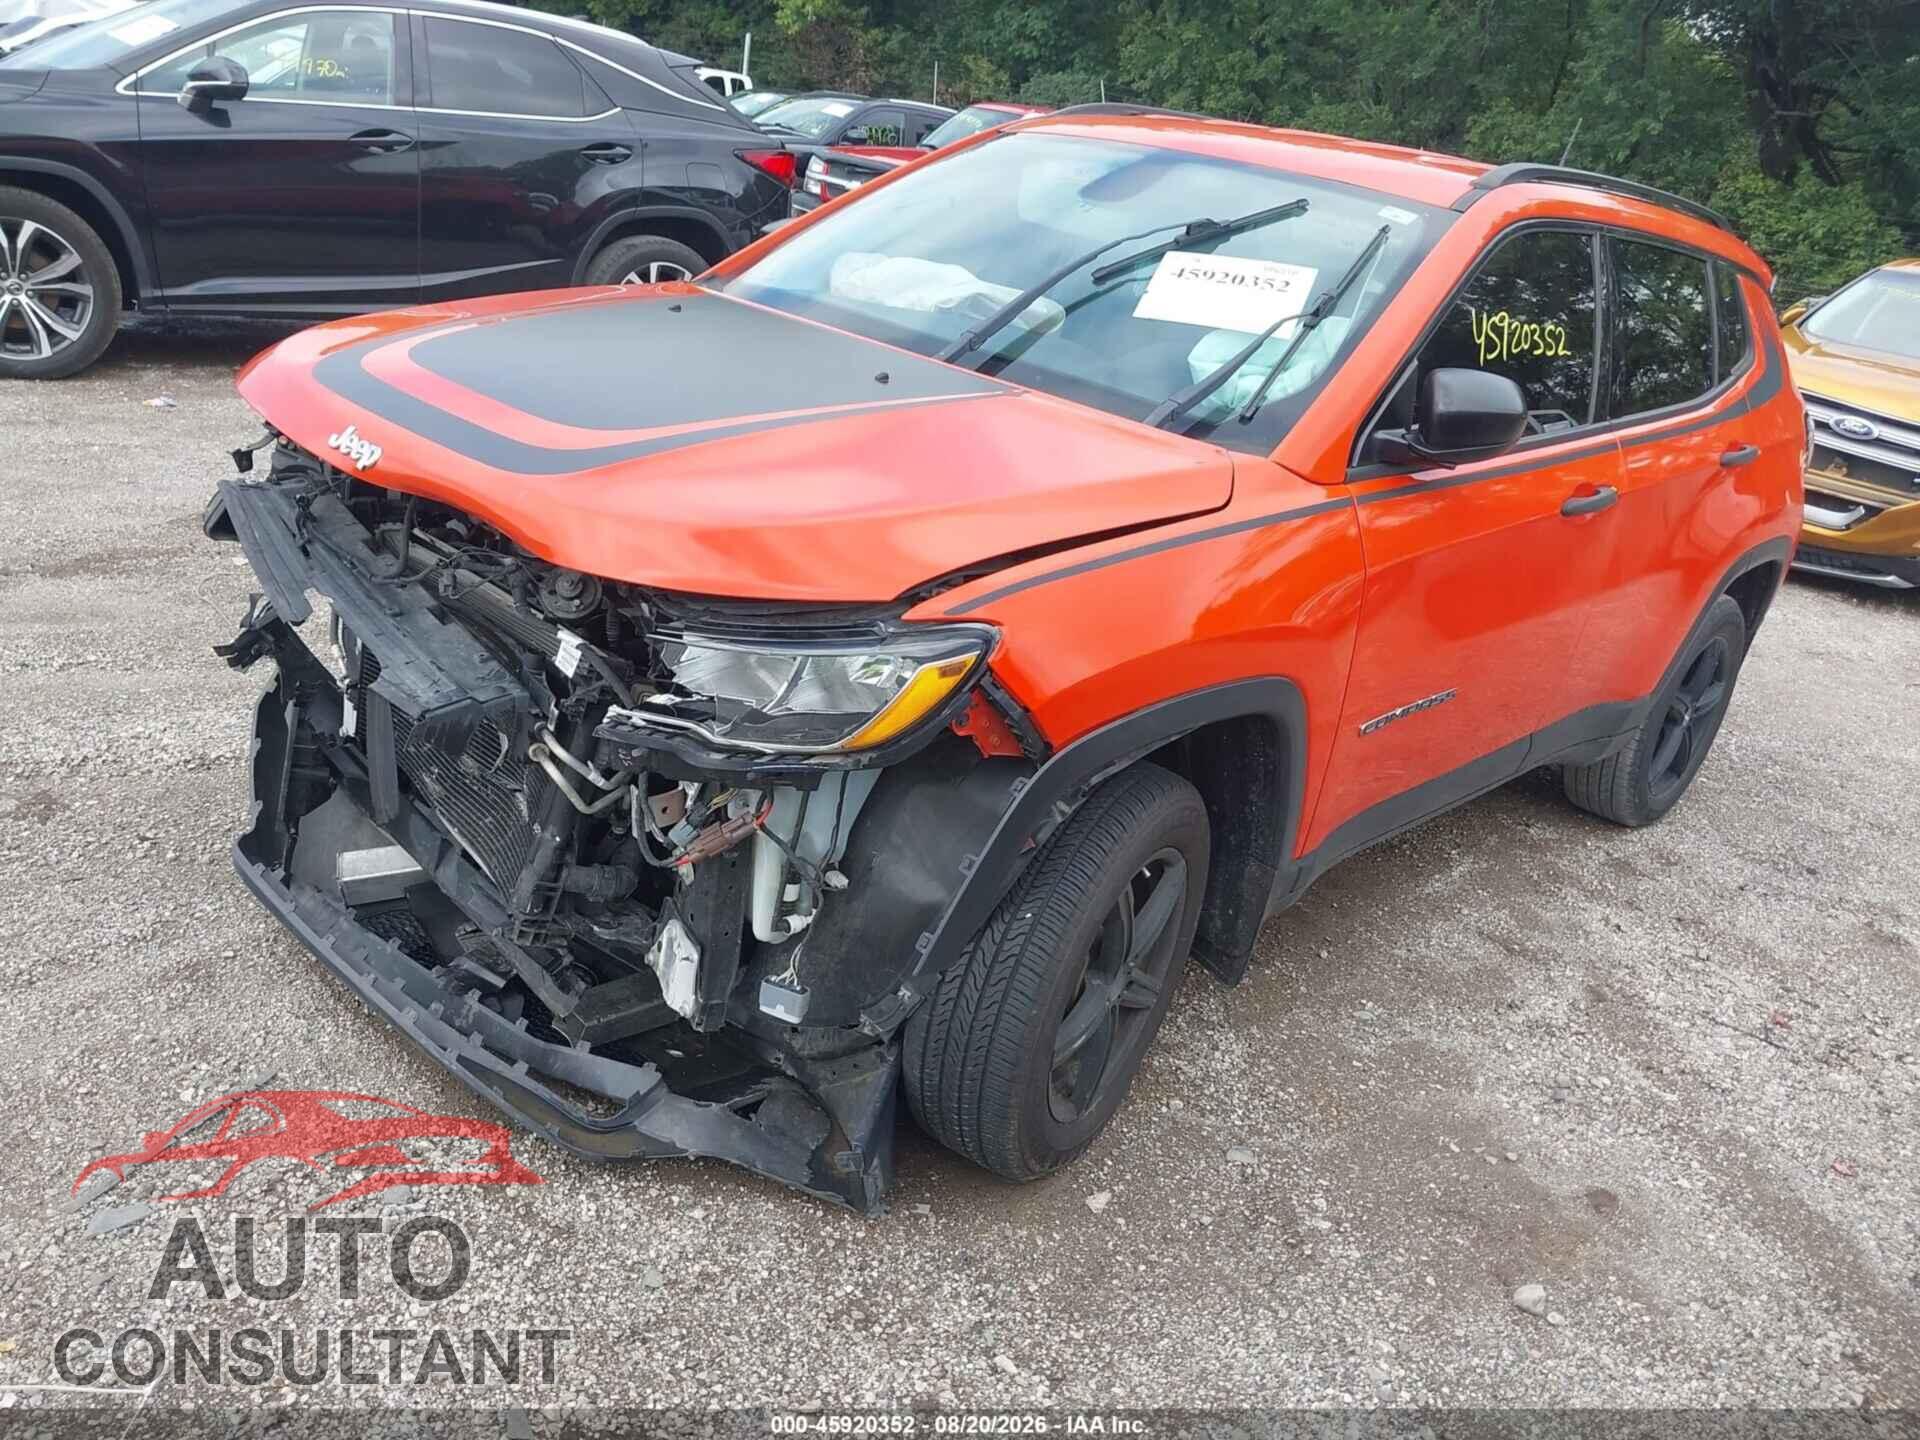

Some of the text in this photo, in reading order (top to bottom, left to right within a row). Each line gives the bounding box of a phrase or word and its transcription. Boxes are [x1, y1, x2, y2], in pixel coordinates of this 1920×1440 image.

[1170, 266, 1292, 293] 45920352
[328, 425, 382, 471] Jeep
[1359, 688, 1458, 736] COMPASS
